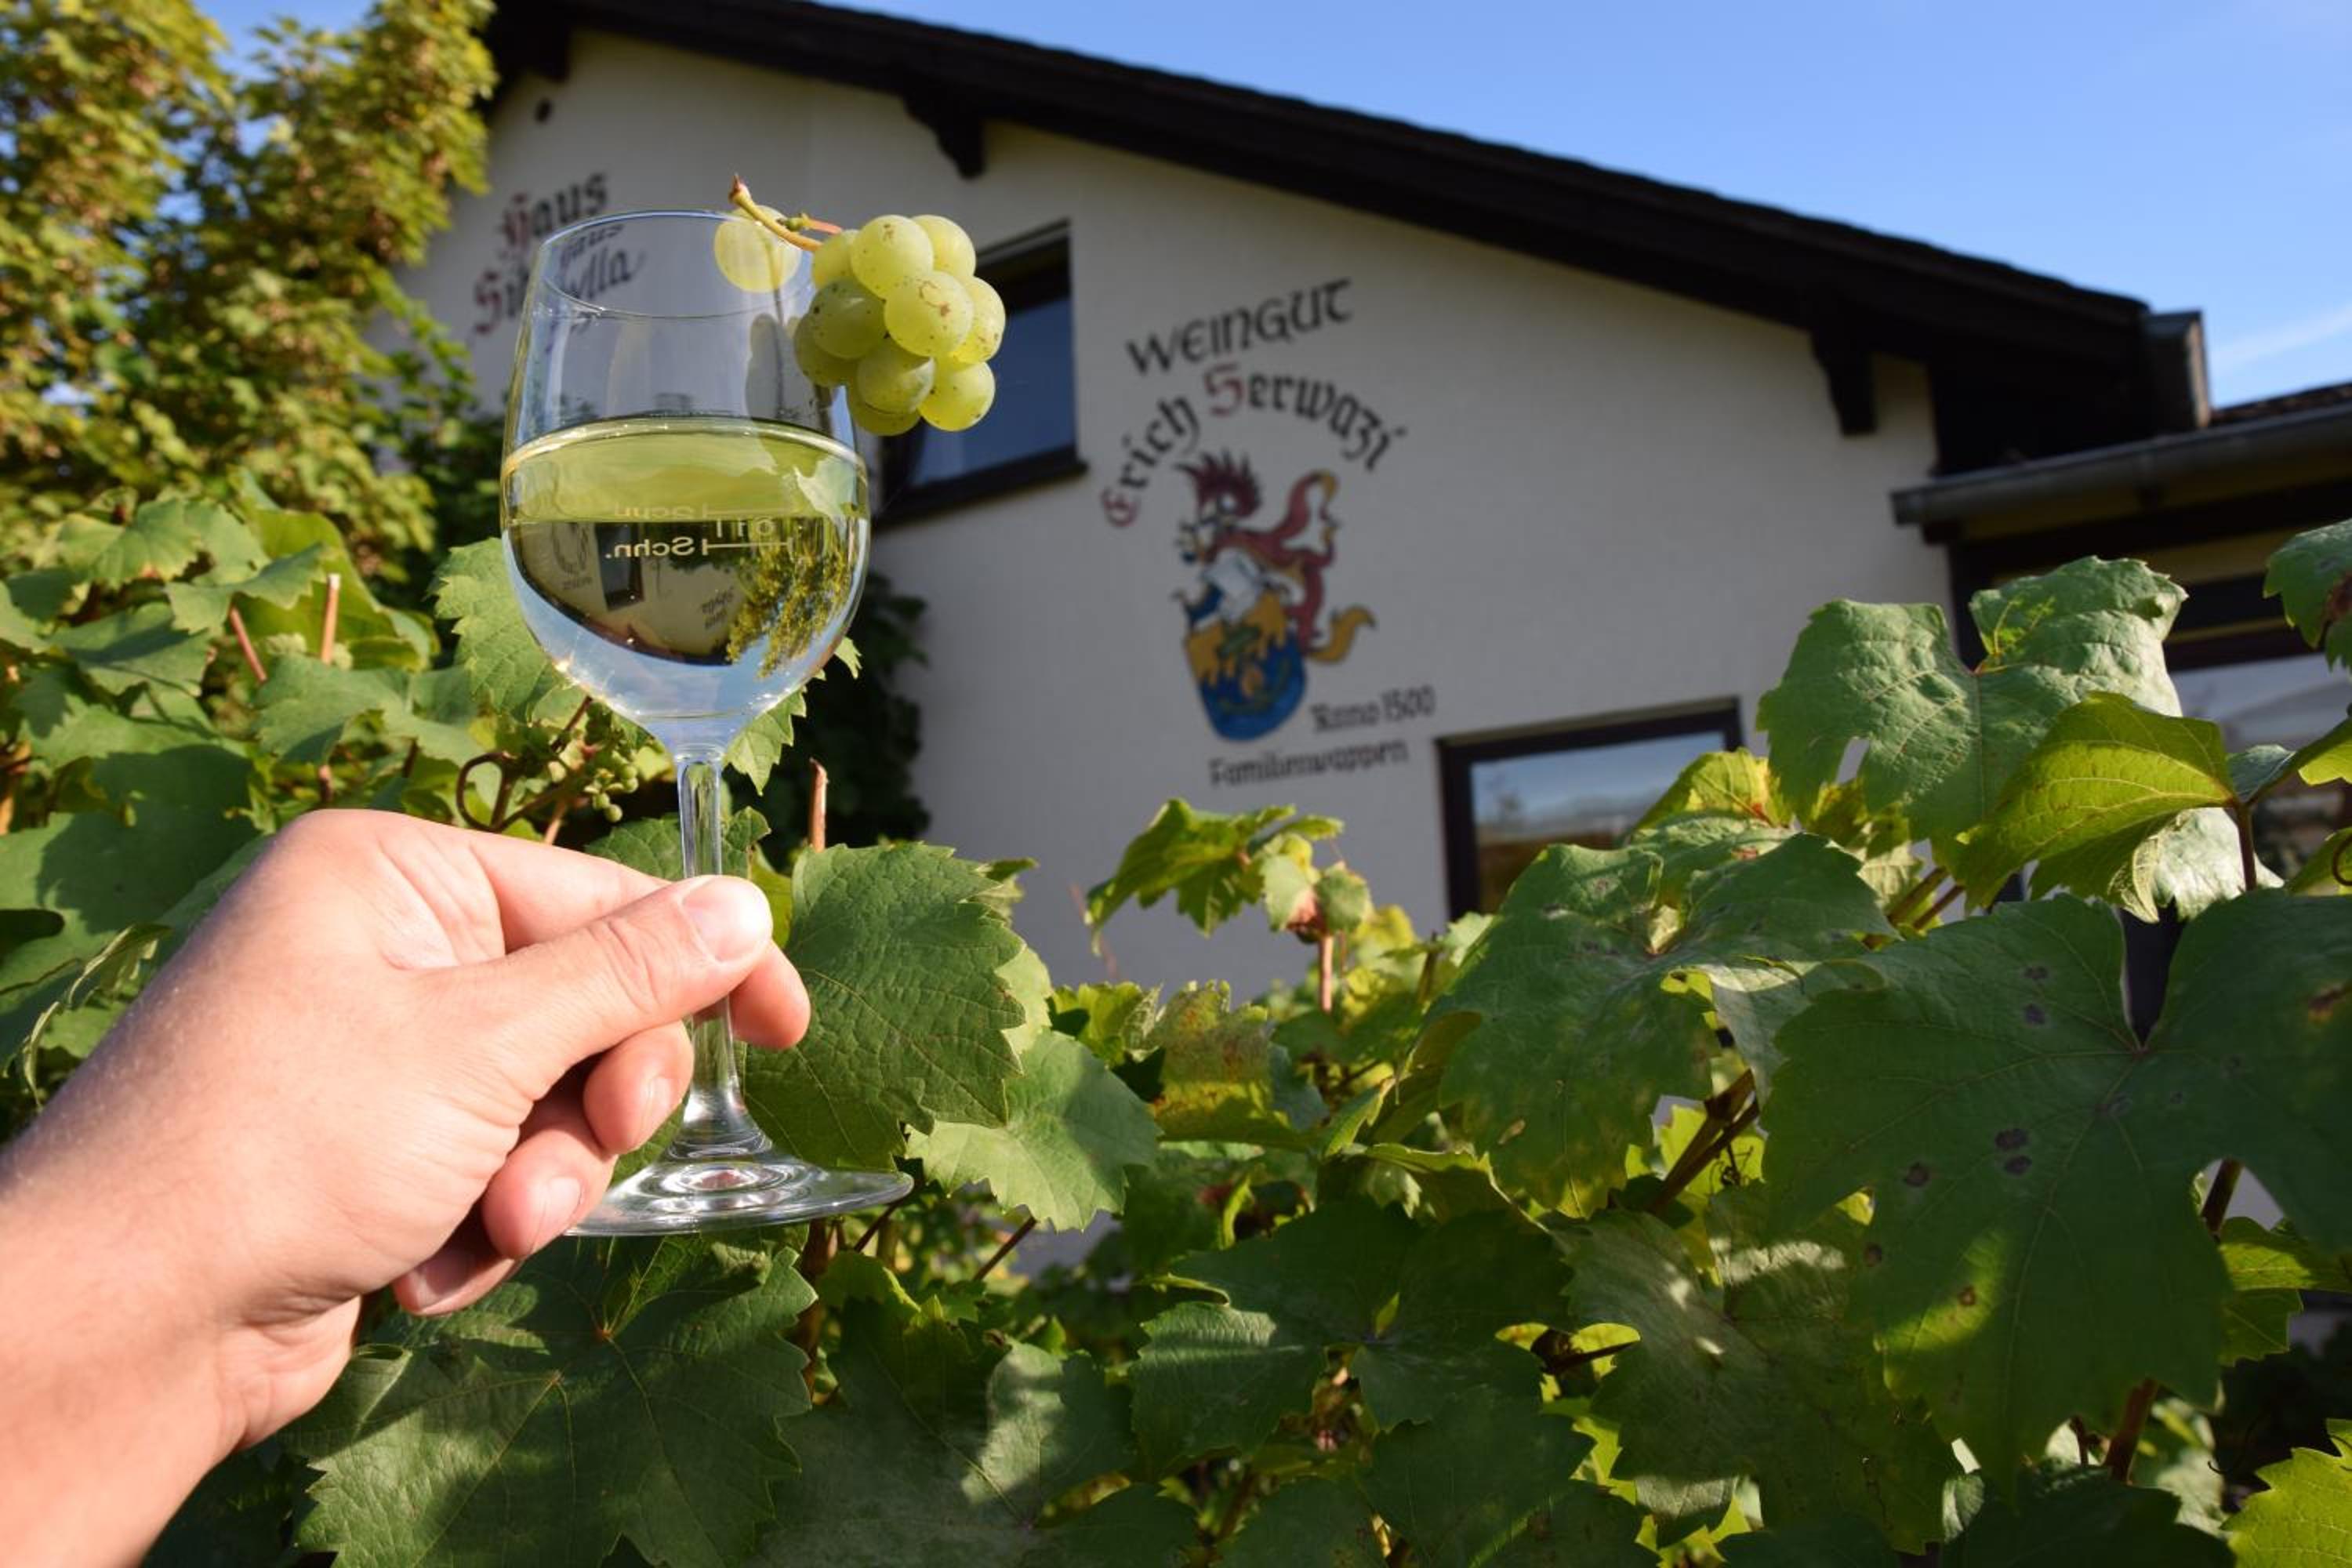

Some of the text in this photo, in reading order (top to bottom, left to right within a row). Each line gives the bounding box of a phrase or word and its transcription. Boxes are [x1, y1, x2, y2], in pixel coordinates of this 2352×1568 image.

[1102, 362, 1407, 528] Erich Serwazi
[1381, 685, 1436, 722] 1500
[1208, 739, 1408, 789] Familienwappen
